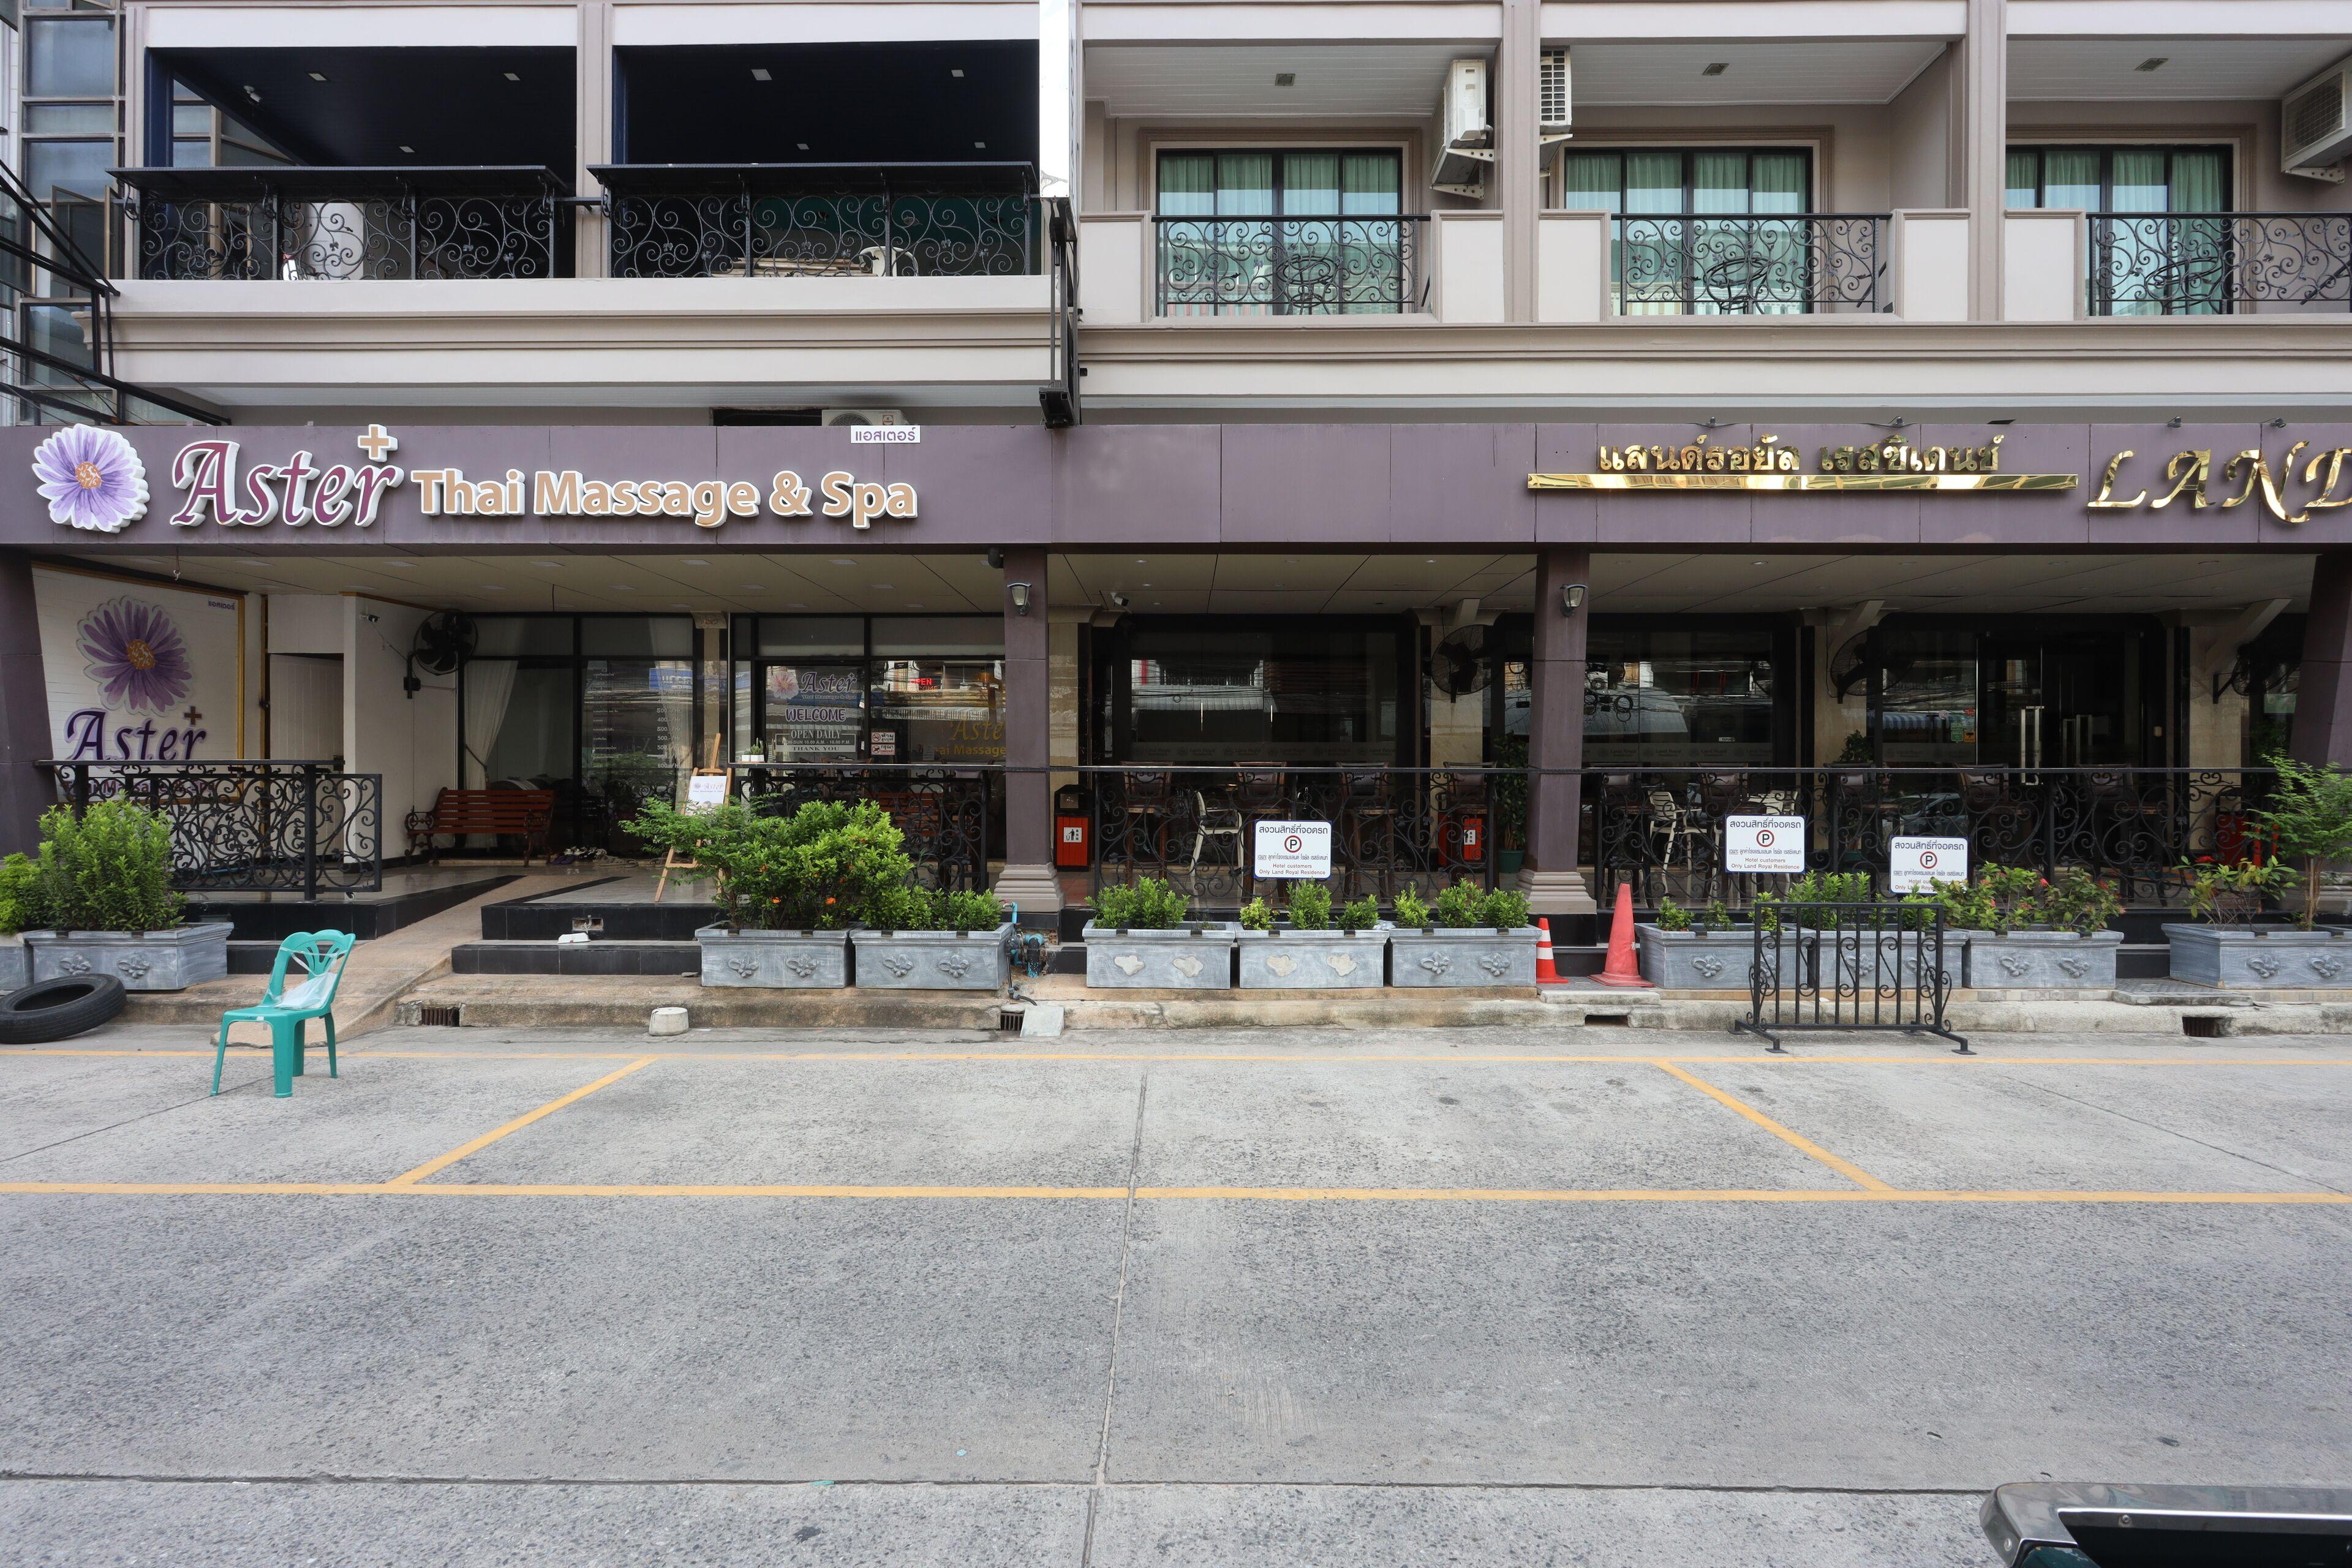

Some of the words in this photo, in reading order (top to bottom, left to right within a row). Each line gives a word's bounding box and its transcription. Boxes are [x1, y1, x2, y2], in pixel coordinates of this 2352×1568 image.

[855, 427, 916, 441] แอสเตอร์
[1599, 433, 1801, 470] แลนด์รอยัล
[170, 440, 405, 527] Aster
[411, 469, 526, 517] Thai
[533, 470, 761, 528] Massage
[769, 470, 813, 517] &
[821, 470, 918, 529] Spa
[2087, 440, 2352, 523] LAND
[208, 600, 236, 611] แอสเตอร์
[801, 671, 857, 693] Aster
[785, 708, 846, 722] WELCOME
[64, 708, 207, 764] Aster
[791, 729, 815, 739] OPEN
[817, 729, 841, 739] DAILY
[953, 744, 1006, 758] Massage
[1259, 824, 1328, 834] สงวนสิทธิ์ที่จอดรถ
[1730, 817, 1801, 829] สงวนสิทธิ์ที่จอดรถ
[1289, 839, 1298, 850] P
[1762, 834, 1770, 843] P
[1894, 840, 1964, 850] สงวนสิทธิ์ที่จอดรถ
[1925, 855, 1933, 865] P
